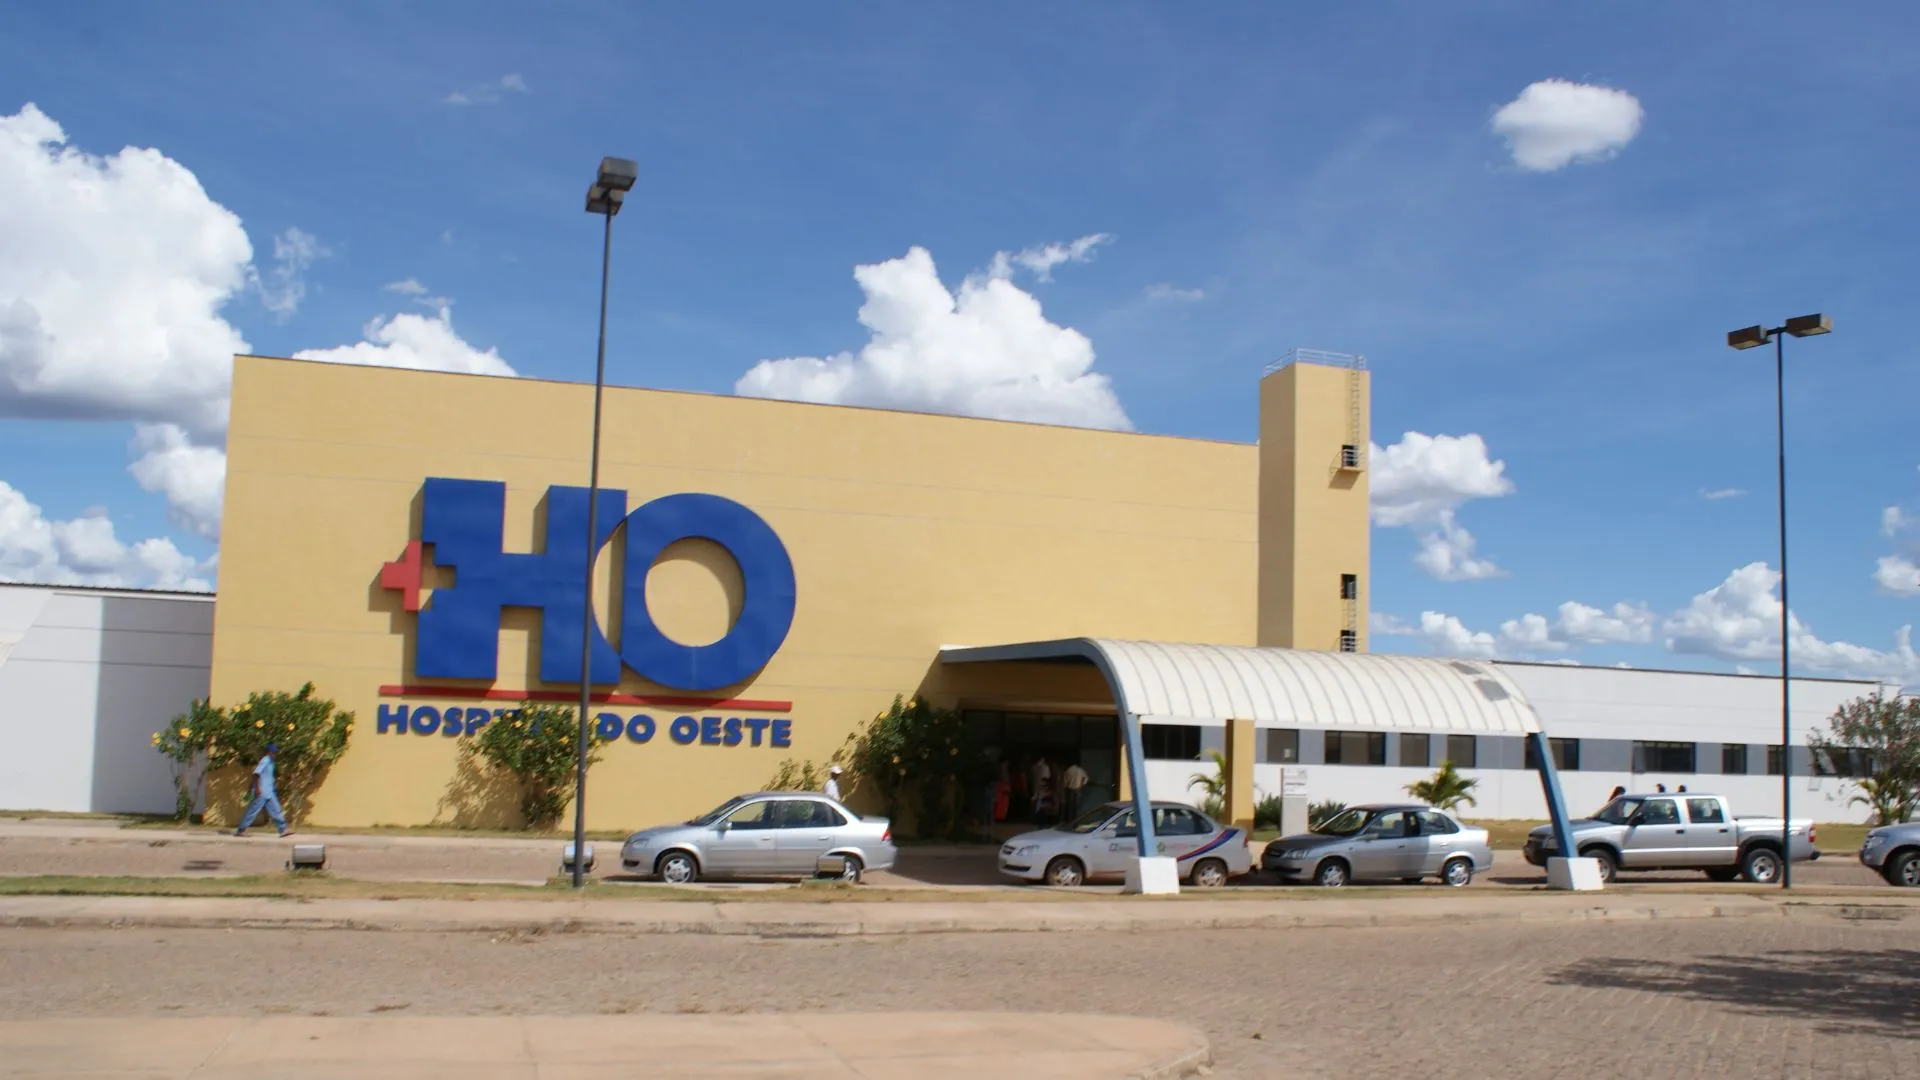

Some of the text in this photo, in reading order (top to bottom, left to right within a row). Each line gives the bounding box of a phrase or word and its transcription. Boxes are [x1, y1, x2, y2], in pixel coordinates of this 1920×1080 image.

[415, 476, 797, 690] HO
[377, 704, 792, 748] HOSP DO OESTE
